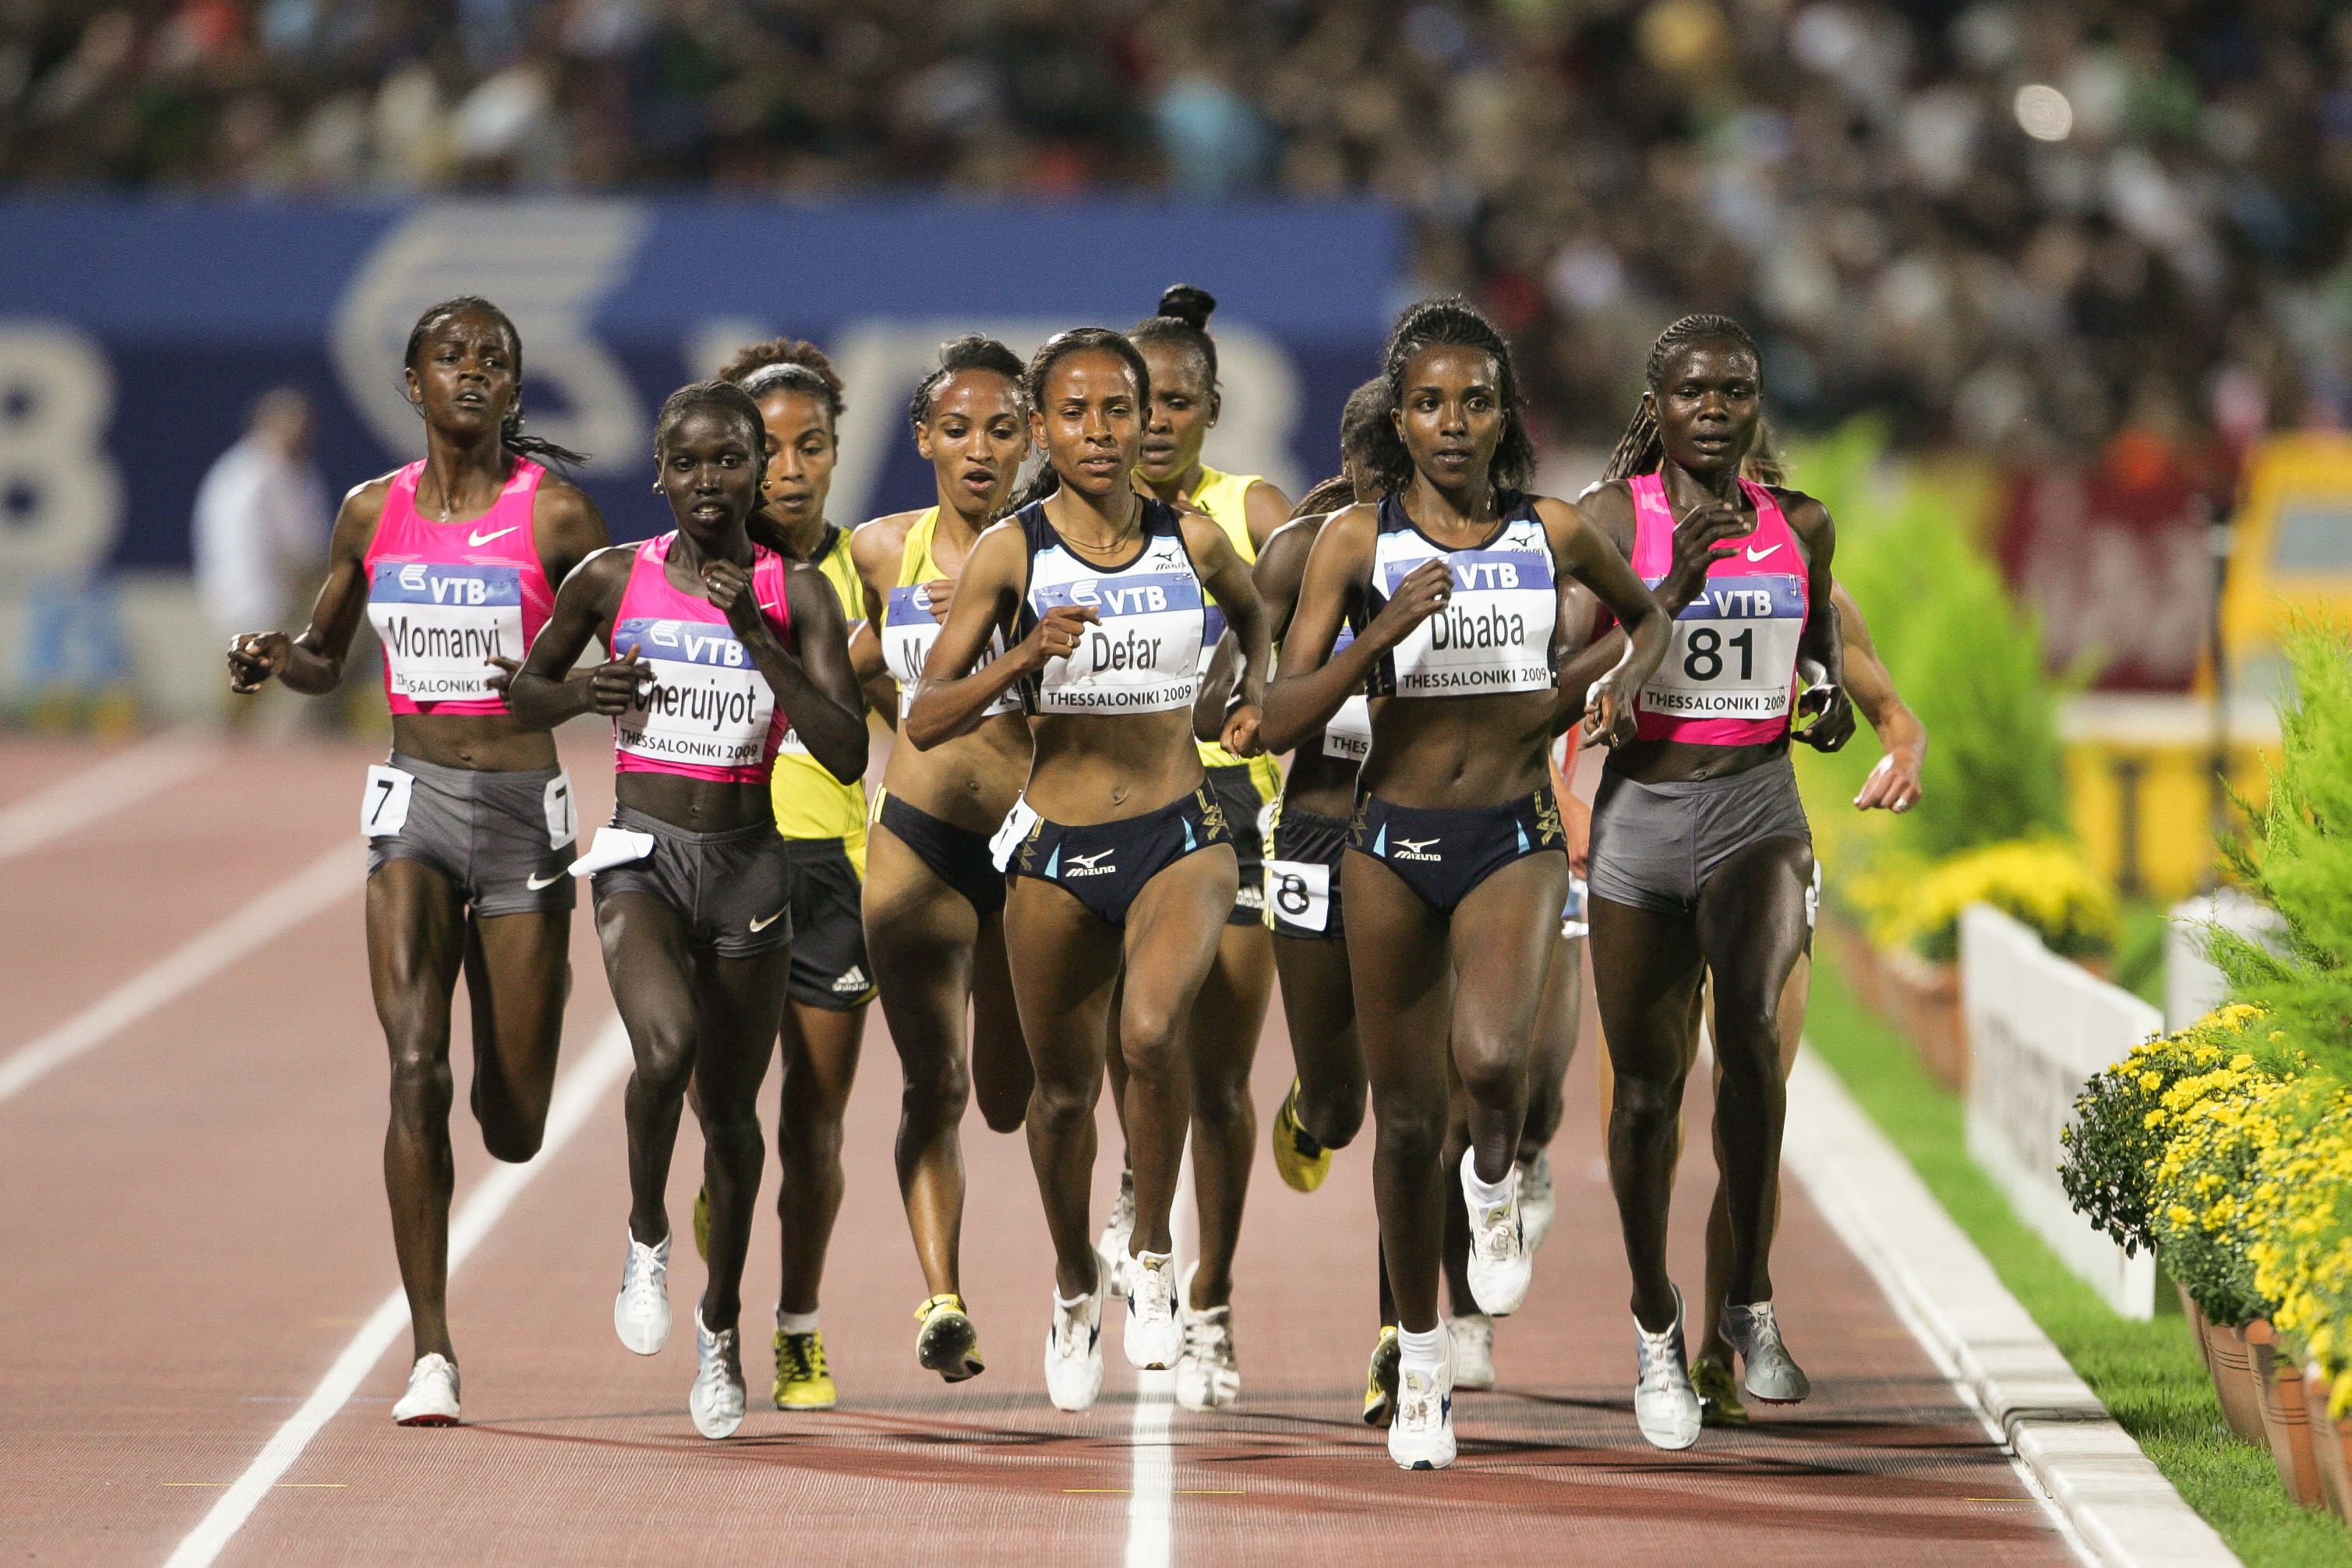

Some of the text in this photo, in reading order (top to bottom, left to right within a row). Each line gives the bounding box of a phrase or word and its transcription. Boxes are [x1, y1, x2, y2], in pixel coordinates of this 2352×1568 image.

[431, 577, 486, 605] VTB
[1457, 563, 1519, 590] VTB
[1104, 586, 1167, 615] VTB
[1713, 590, 1772, 617] VTB
[388, 616, 501, 666] Momanyi
[1431, 604, 1524, 652] Dibaba
[683, 634, 743, 667] VTB
[1093, 629, 1161, 672] Defar
[1683, 627, 1753, 682] 81
[1404, 668, 1546, 689] THESSALONIKI 2009
[1047, 684, 1192, 707] THESSALONIKI 2009
[1646, 691, 1759, 711] THESSALONIKI
[620, 728, 758, 759] THESSALONIKI 2009
[370, 779, 394, 825] 7
[1277, 874, 1310, 915] 8
